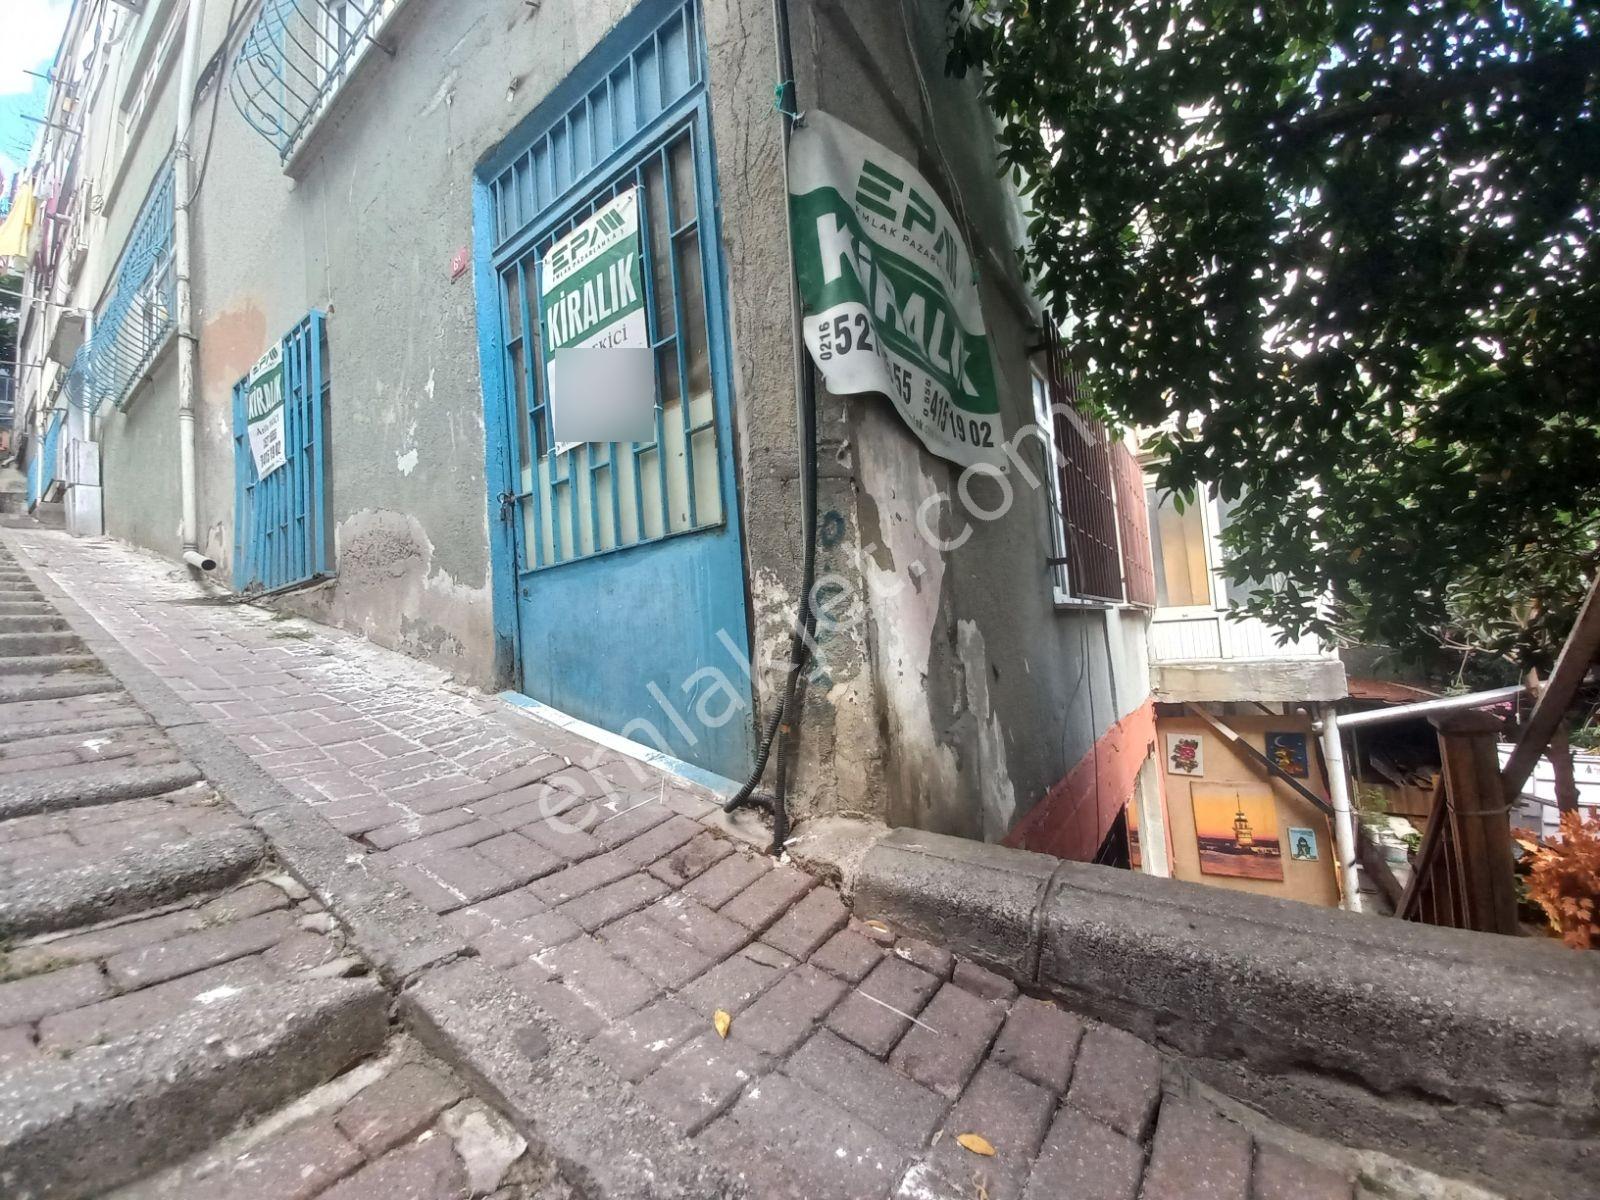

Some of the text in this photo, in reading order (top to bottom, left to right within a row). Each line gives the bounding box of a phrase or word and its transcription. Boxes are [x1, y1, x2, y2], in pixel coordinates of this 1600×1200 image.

[855, 204, 898, 237] EMLAK
[547, 252, 637, 352] KİRALIK
[819, 321, 833, 361] 0216
[930, 390, 949, 432] 415
[950, 410, 966, 443] 19
[969, 419, 994, 448] 02
